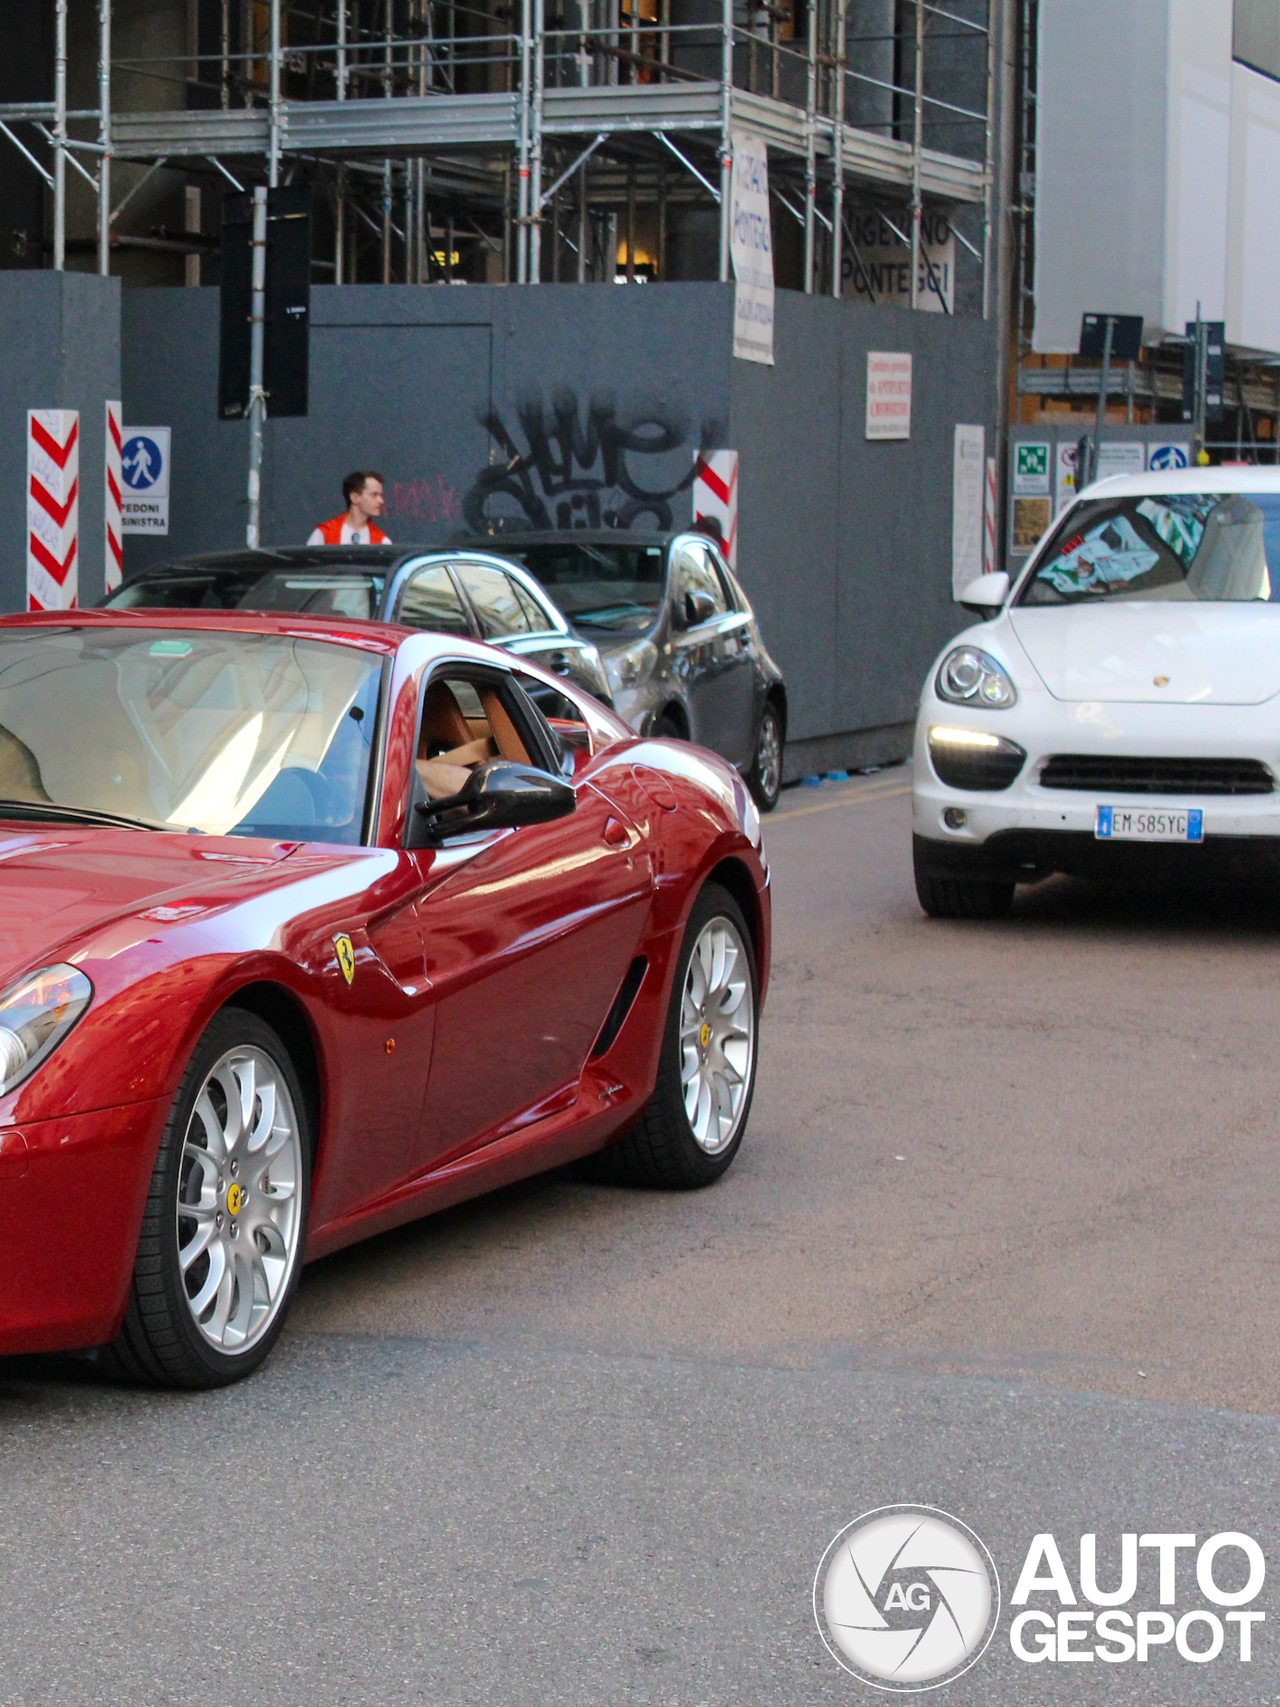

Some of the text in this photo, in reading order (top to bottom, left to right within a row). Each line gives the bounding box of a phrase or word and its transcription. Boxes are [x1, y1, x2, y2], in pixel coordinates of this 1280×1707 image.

[121, 504, 160, 513] PEDONI
[121, 518, 166, 527] SINISTRA
[1112, 814, 1132, 832] EM
